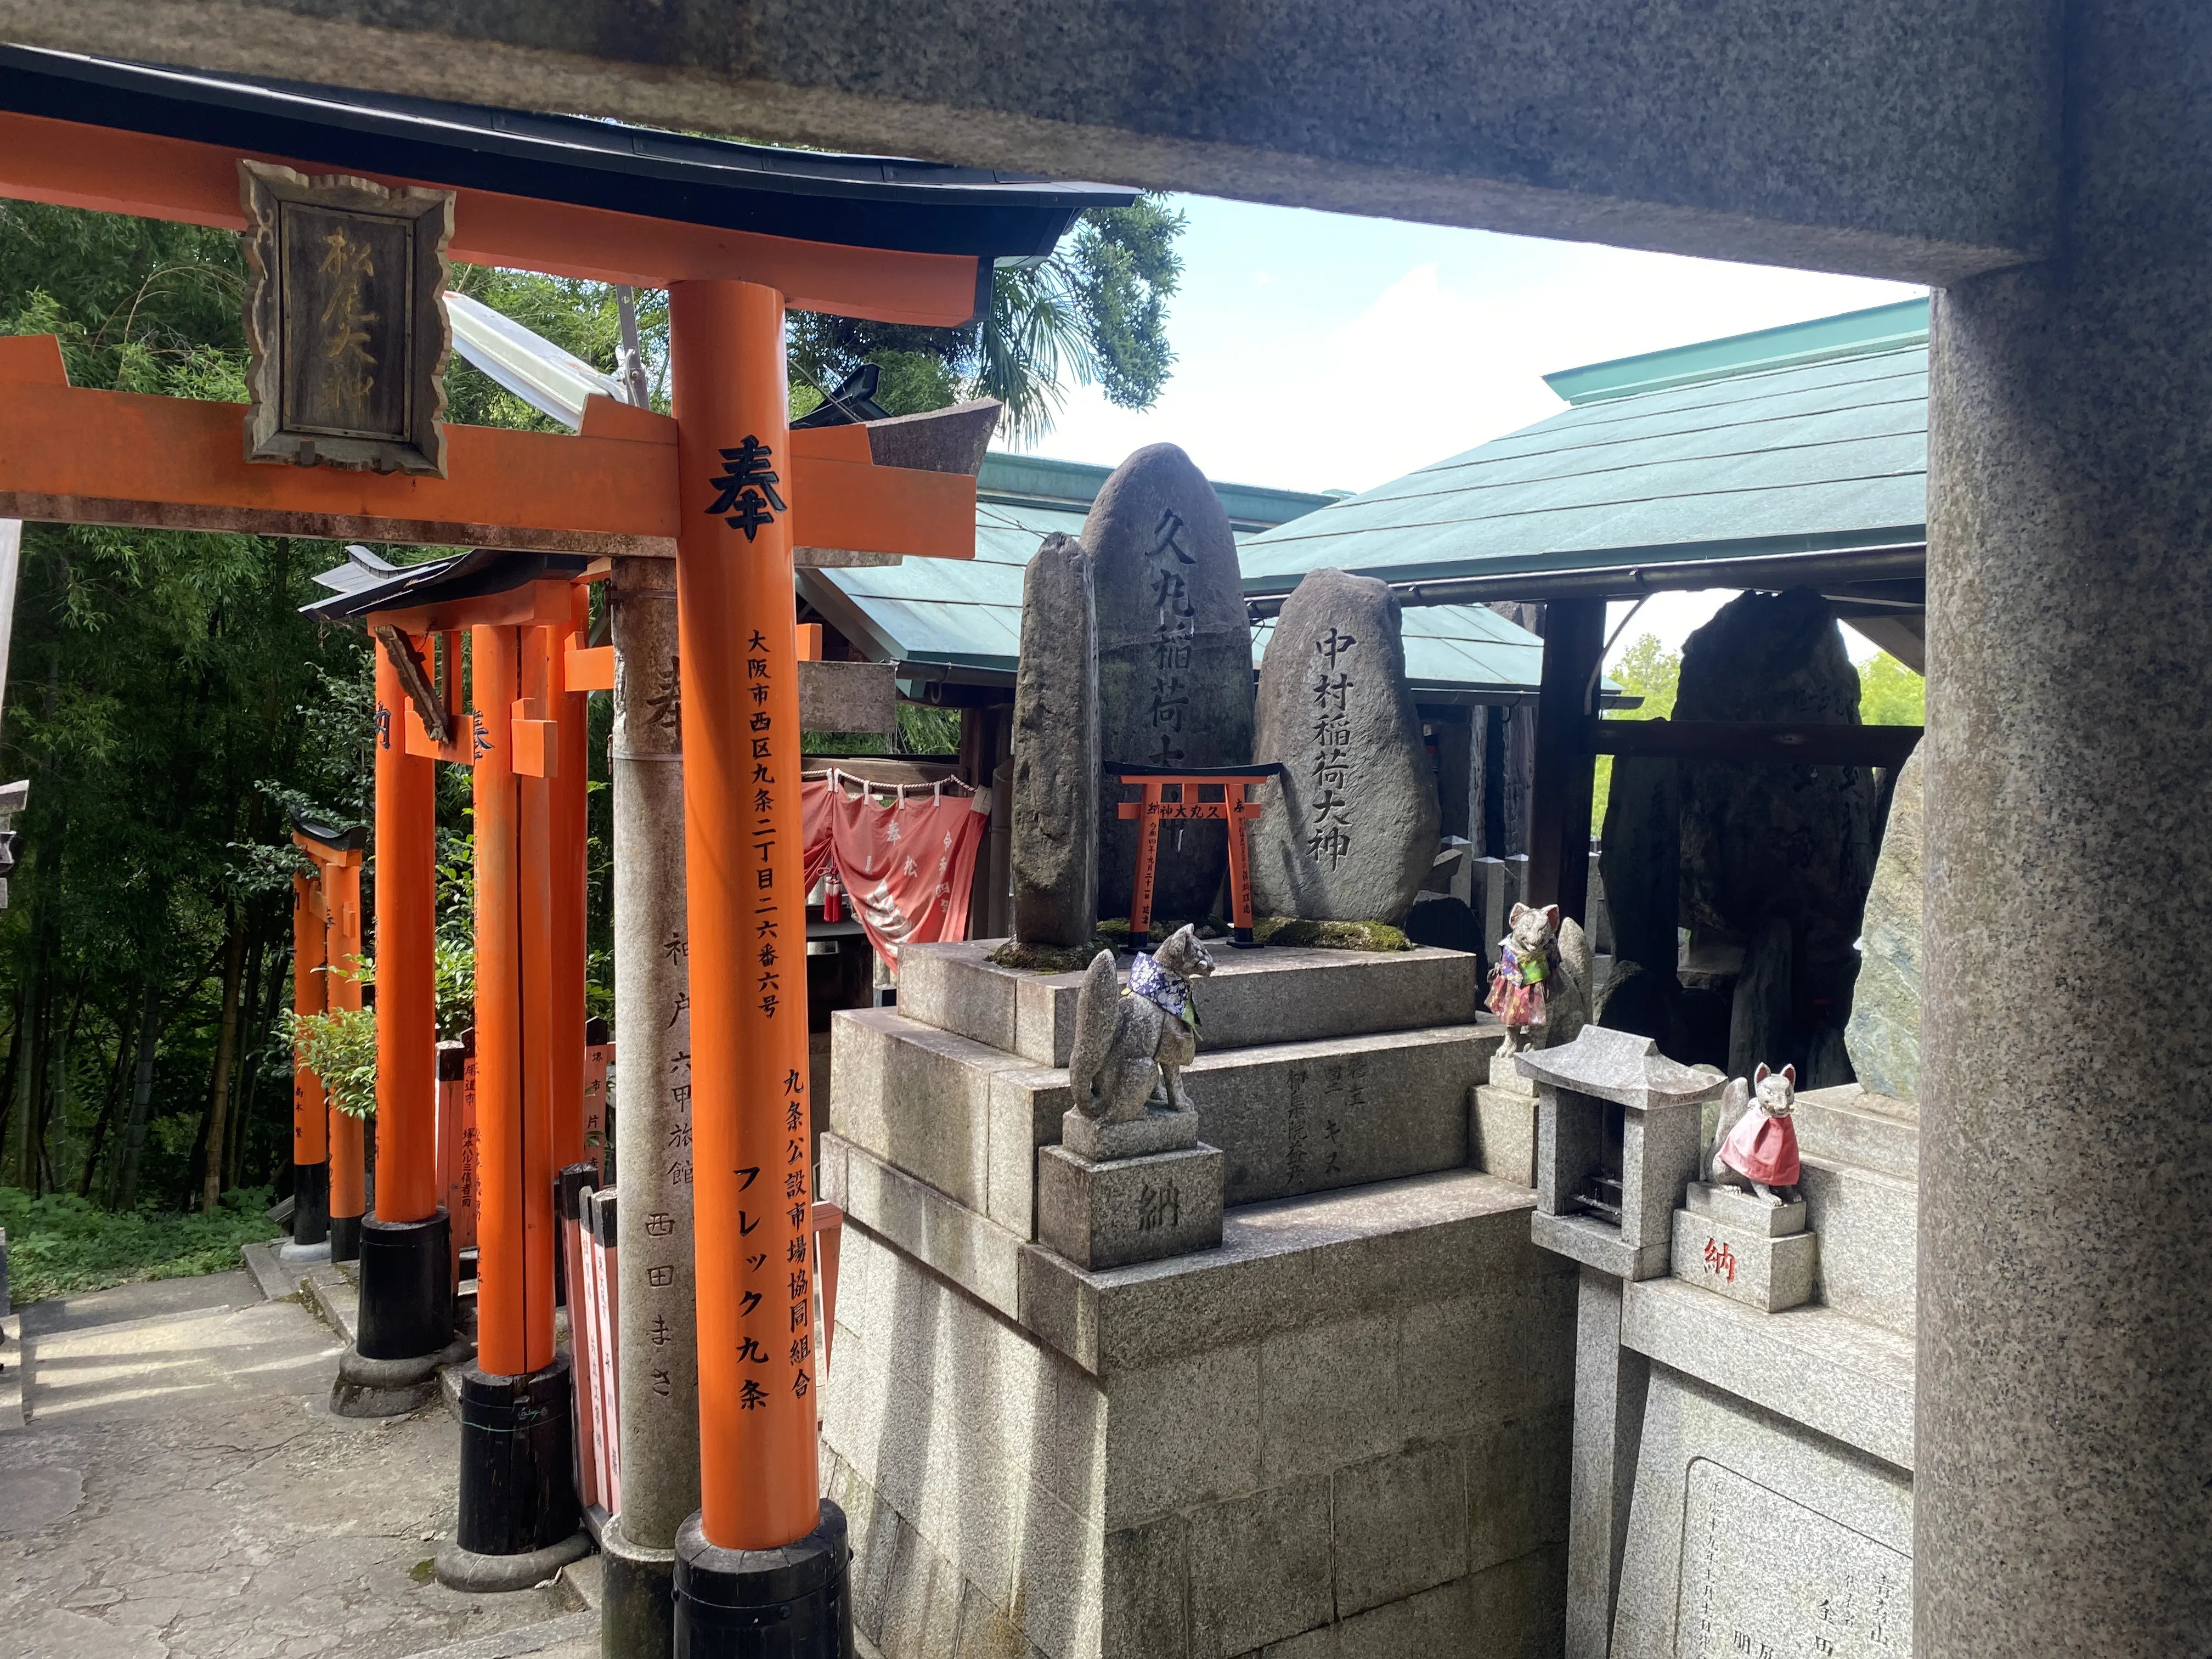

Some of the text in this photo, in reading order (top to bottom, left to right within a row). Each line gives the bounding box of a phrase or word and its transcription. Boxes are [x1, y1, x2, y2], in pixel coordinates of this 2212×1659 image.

[704, 435, 787, 543] 奉
[747, 629, 781, 1019] 大阪市西区九条二丁目二六番六号
[887, 820, 901, 846] 奉
[1306, 628, 1357, 872] 中村稲荷大神
[732, 1166, 770, 1412] フレック九条
[783, 1068, 812, 1400] 九条公設市場協同組合
[1703, 1237, 1736, 1283] 納
